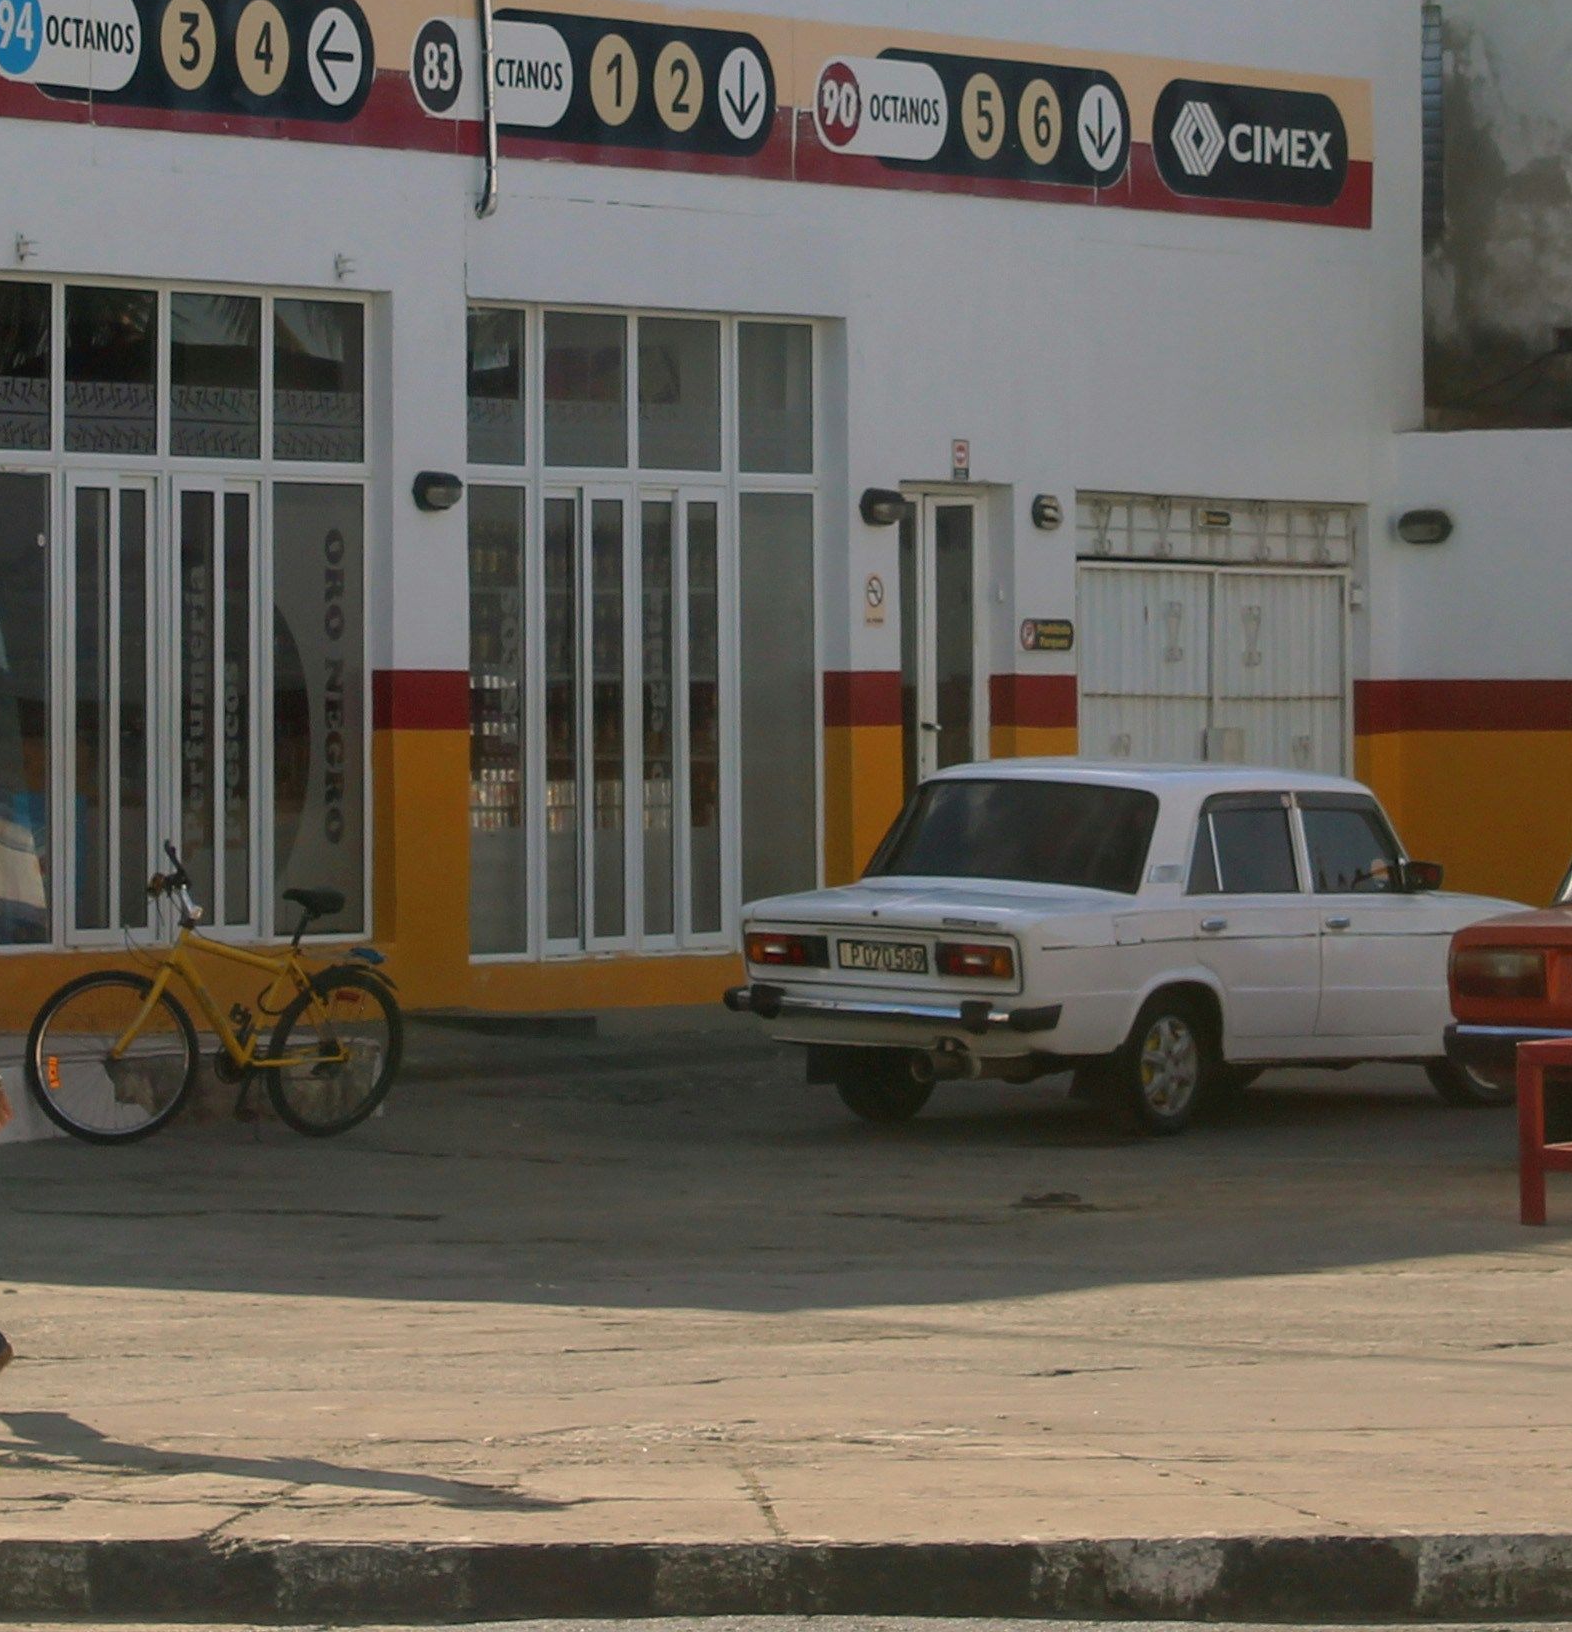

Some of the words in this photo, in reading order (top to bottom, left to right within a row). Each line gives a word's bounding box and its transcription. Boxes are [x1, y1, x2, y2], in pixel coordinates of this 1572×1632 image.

[45, 13, 134, 56] OCTANOS
[178, 11, 201, 71] 3
[254, 21, 273, 74] 4
[422, 41, 455, 91] 83
[494, 58, 563, 91] CTANOS
[606, 52, 622, 107] 1
[671, 60, 690, 112] 2
[822, 78, 858, 128] 90
[869, 90, 940, 128] OCTANOS
[976, 90, 993, 141] 5
[1034, 96, 1051, 145] 6
[1228, 122, 1332, 171] CIMEX
[323, 528, 346, 641] ORO
[323, 658, 346, 845] NEGRO
